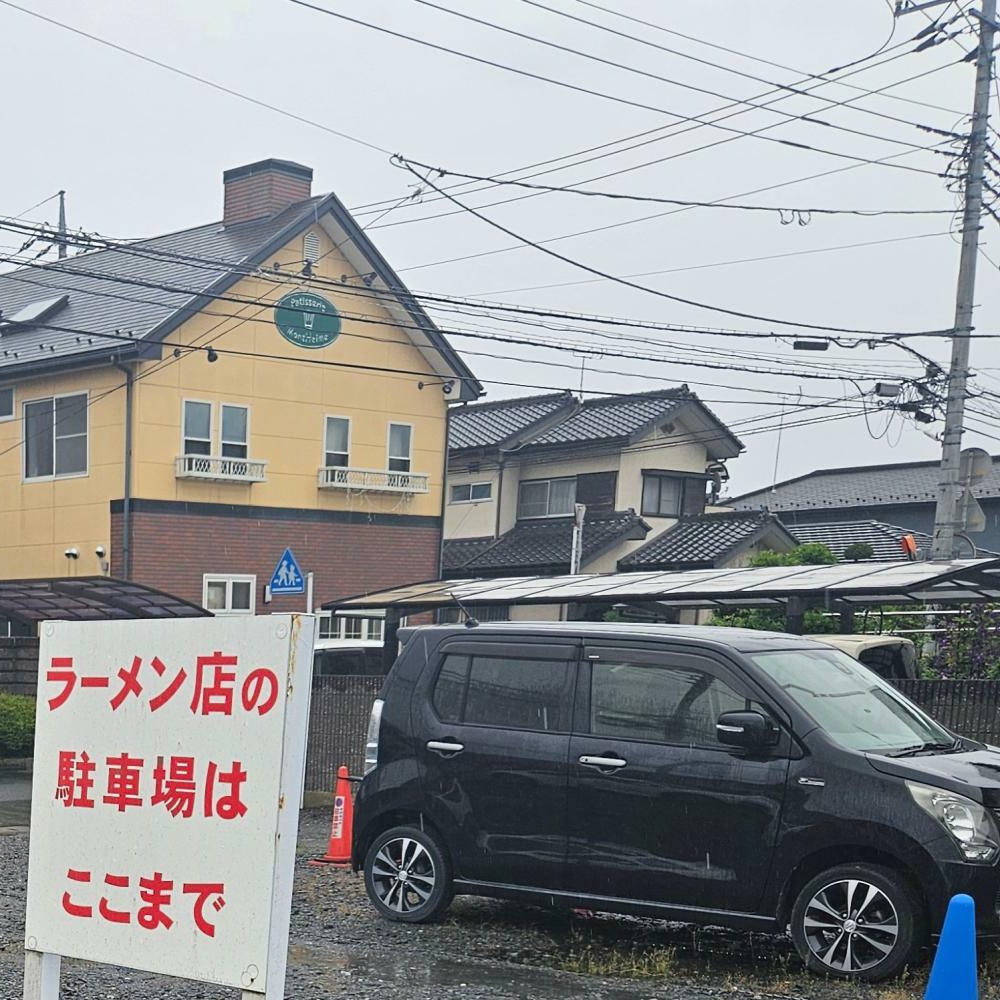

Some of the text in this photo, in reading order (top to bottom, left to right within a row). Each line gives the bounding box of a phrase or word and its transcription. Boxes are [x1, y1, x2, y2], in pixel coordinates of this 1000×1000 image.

[46, 651, 279, 716] ラーメン店の
[55, 751, 248, 820] 駐車場は
[61, 868, 226, 938] ここまで
